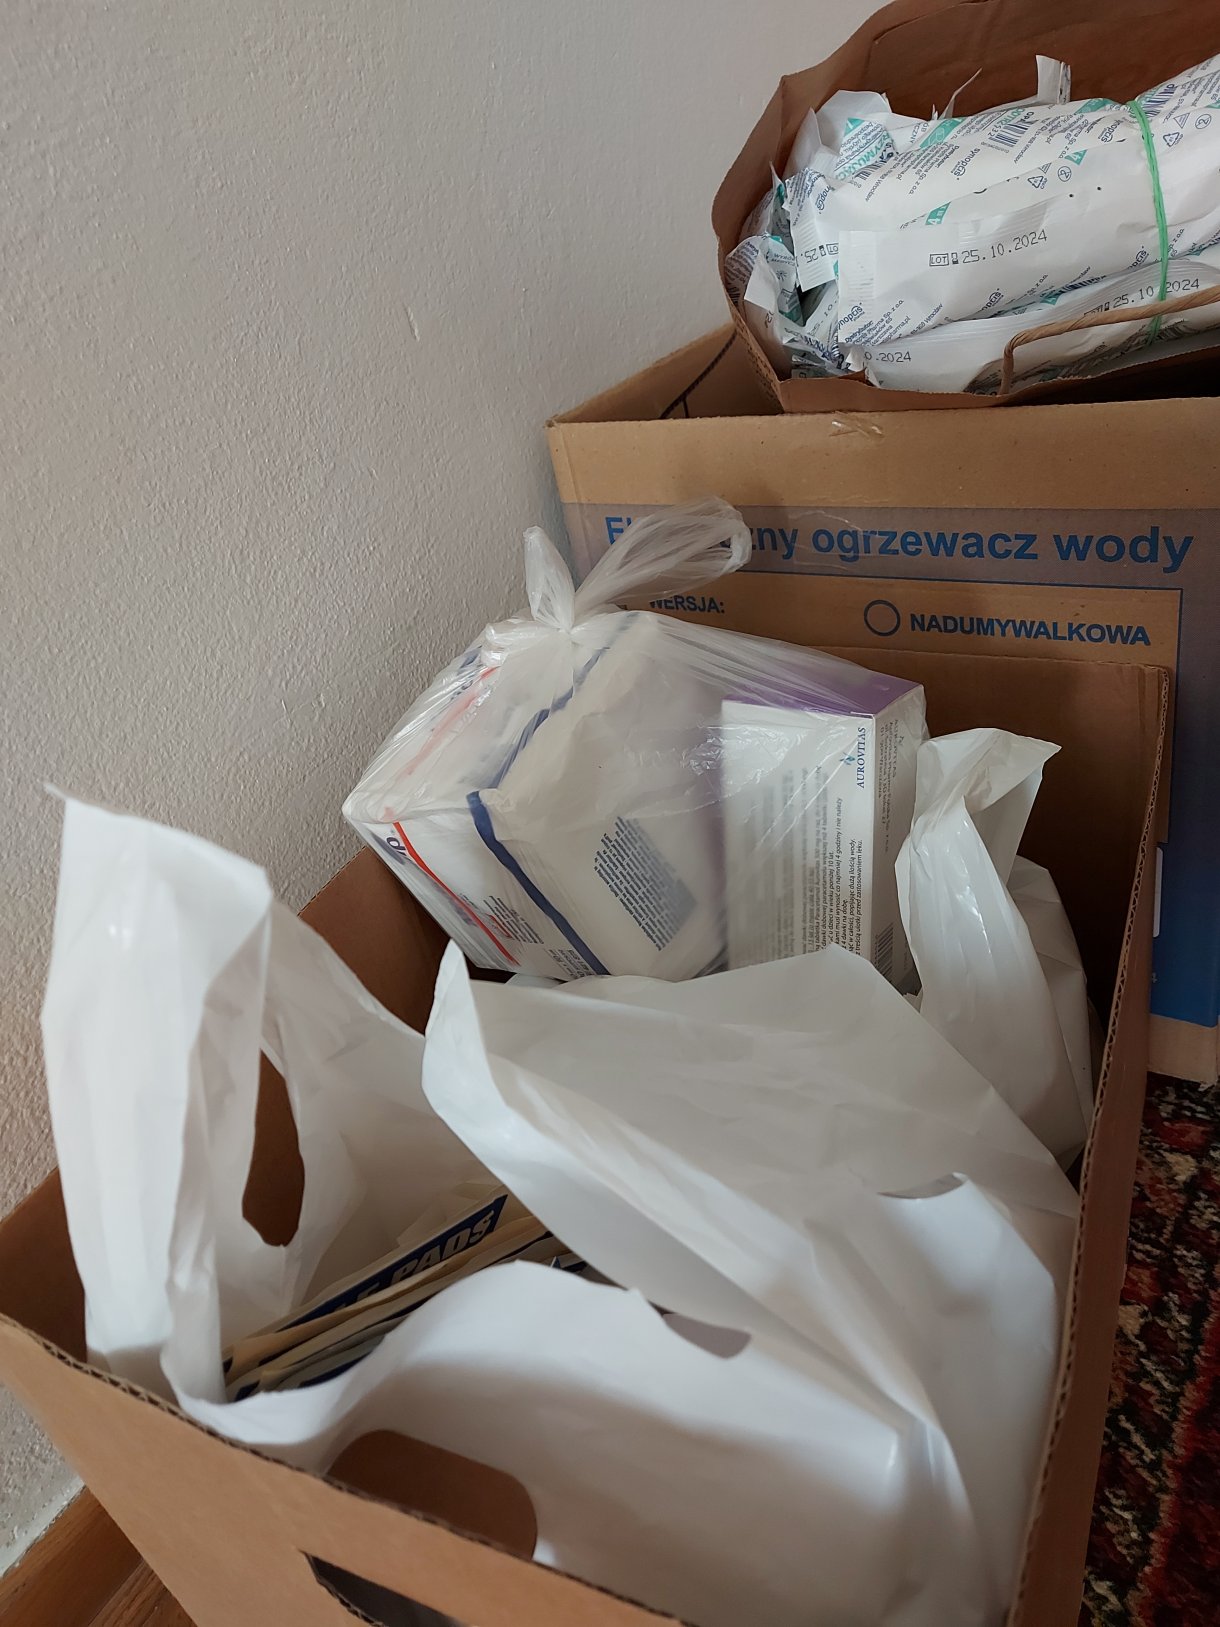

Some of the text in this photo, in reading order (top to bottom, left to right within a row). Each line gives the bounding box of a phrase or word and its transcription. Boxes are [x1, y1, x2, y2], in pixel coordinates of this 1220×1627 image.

[961, 229, 1048, 264] 25.10.2024
[1113, 278, 1200, 309] 25.102024
[812, 528, 1038, 563] ogrzewacz
[1053, 525, 1194, 573] wody
[910, 613, 1151, 647] NADUMYWALKOWA
[856, 727, 866, 789] AUROVITAS
[391, 1209, 494, 1285] PADS
